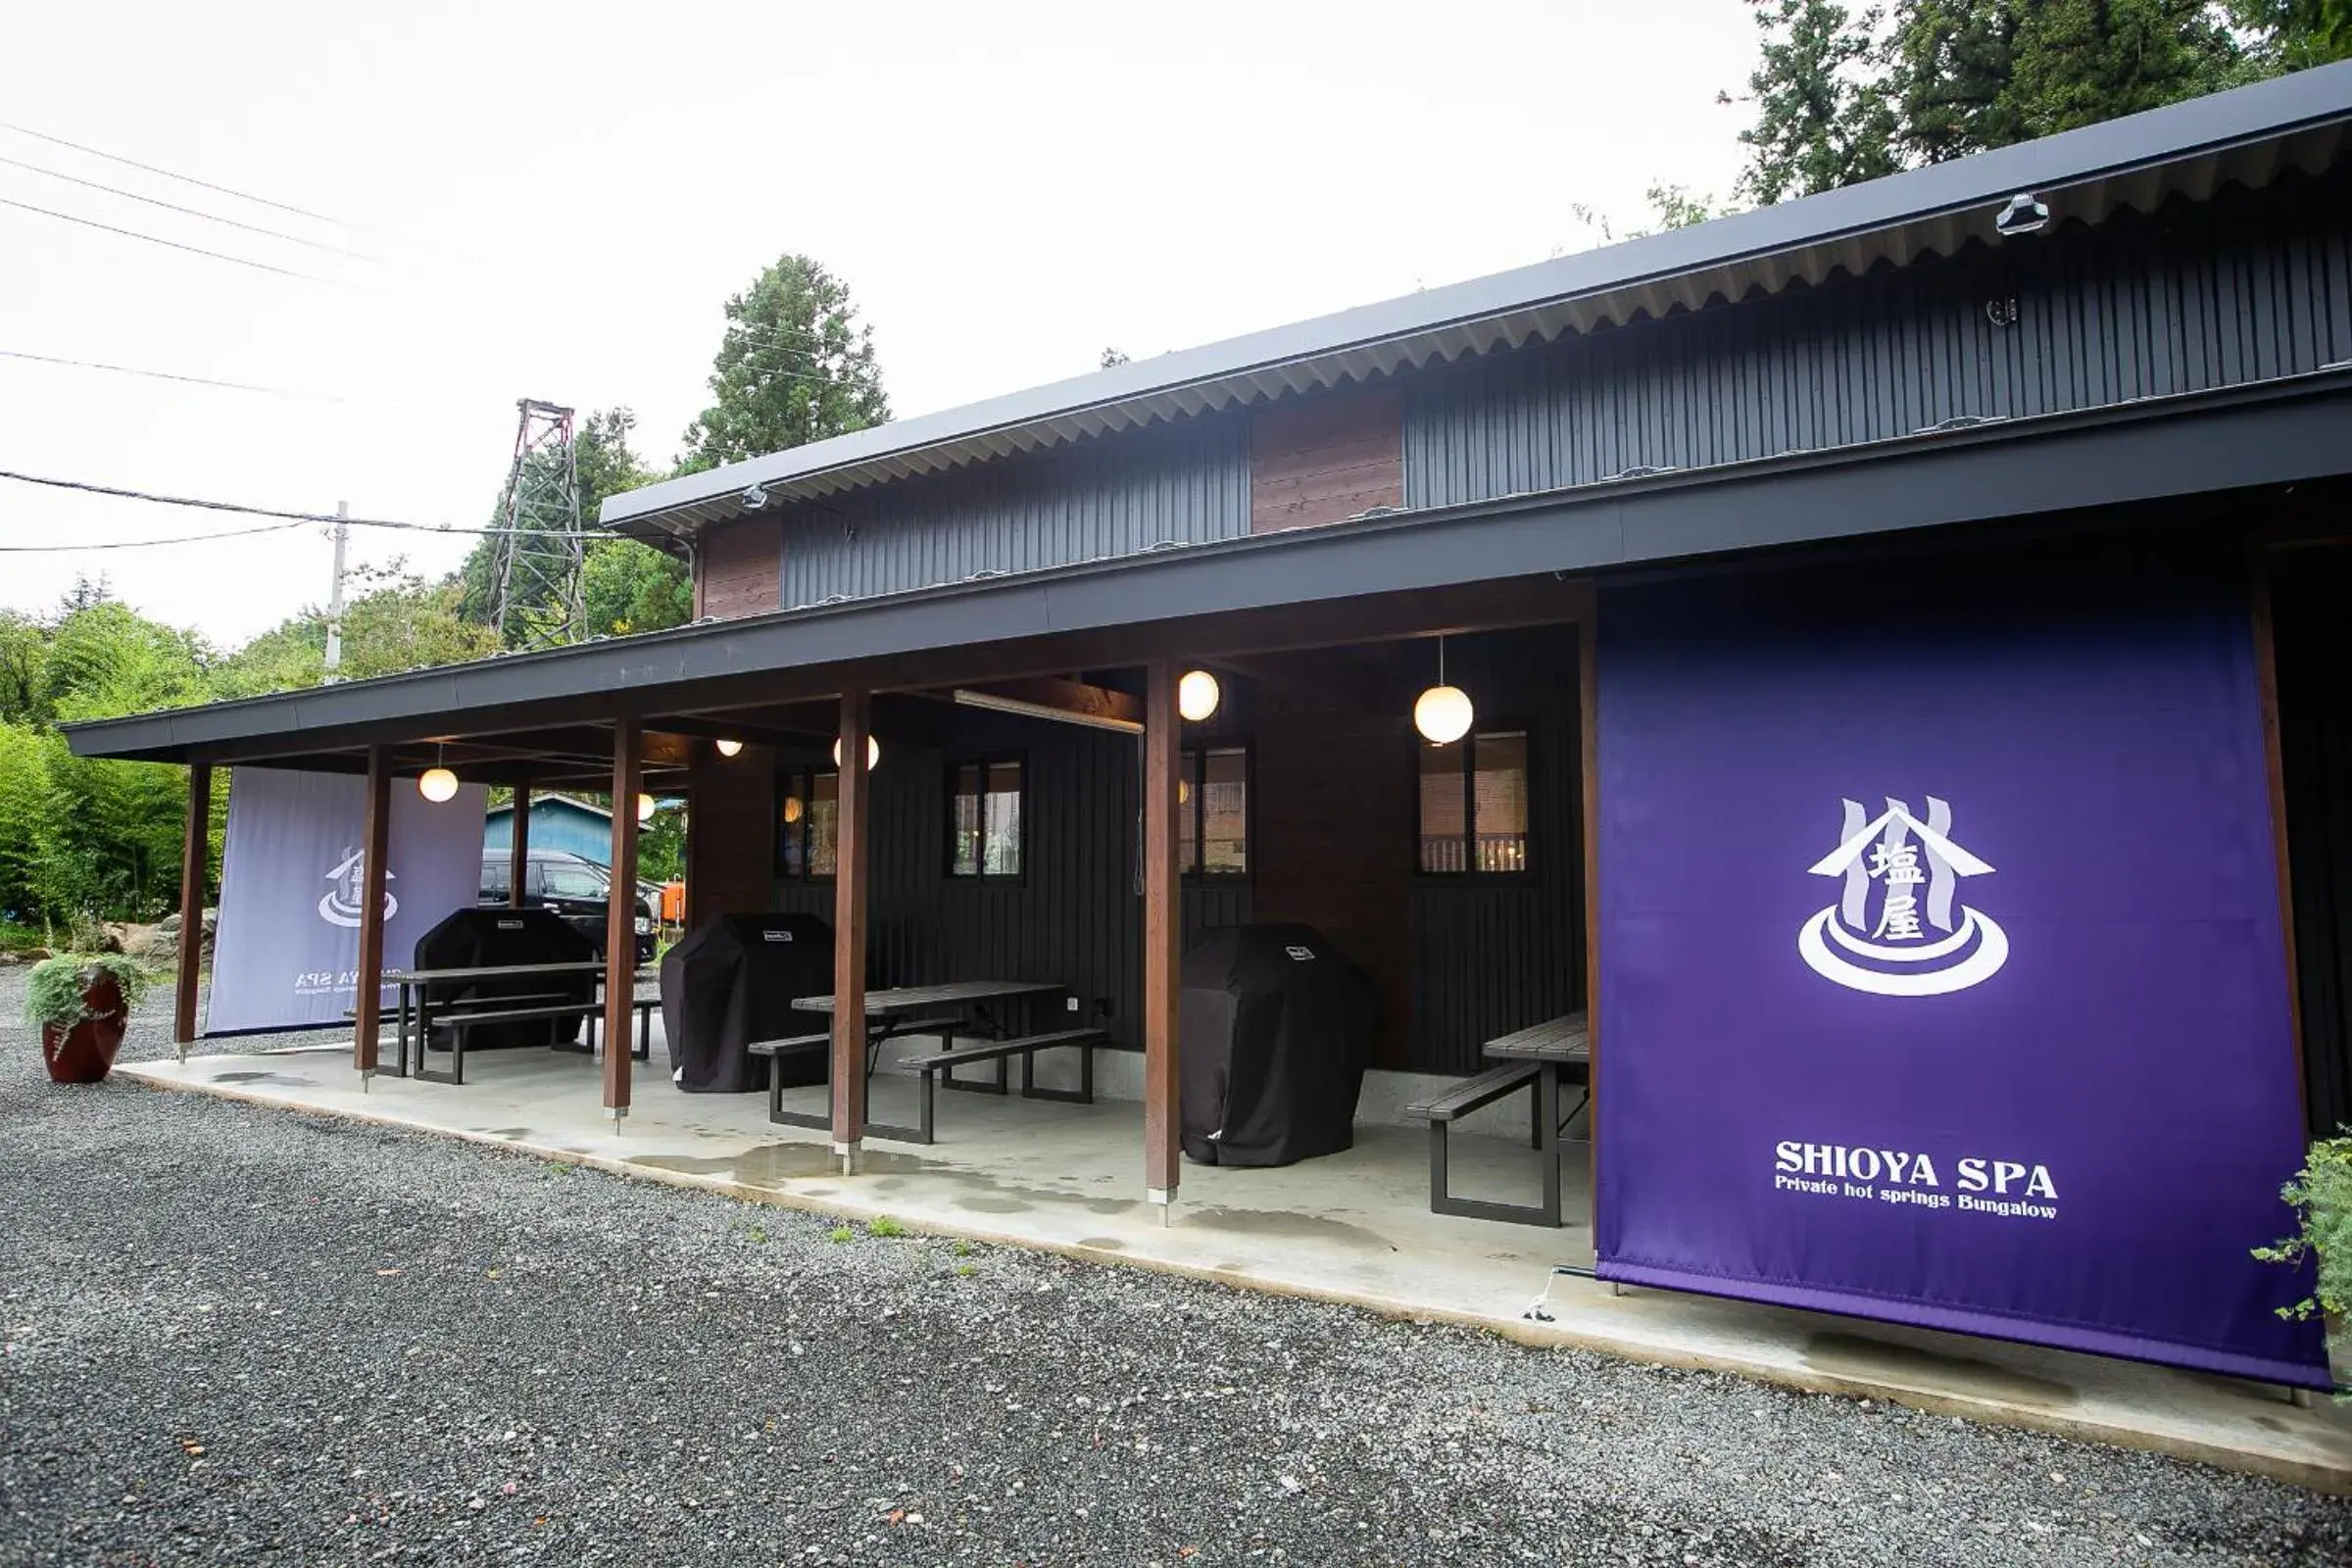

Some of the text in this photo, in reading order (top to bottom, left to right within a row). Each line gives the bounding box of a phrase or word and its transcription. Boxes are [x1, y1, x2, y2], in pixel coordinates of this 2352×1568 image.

[1868, 842, 1927, 941] 塩屋
[1775, 1141, 2059, 1200] SHIOYA SPA
[1775, 1175, 2057, 1220] Private hot springs Bungalow
